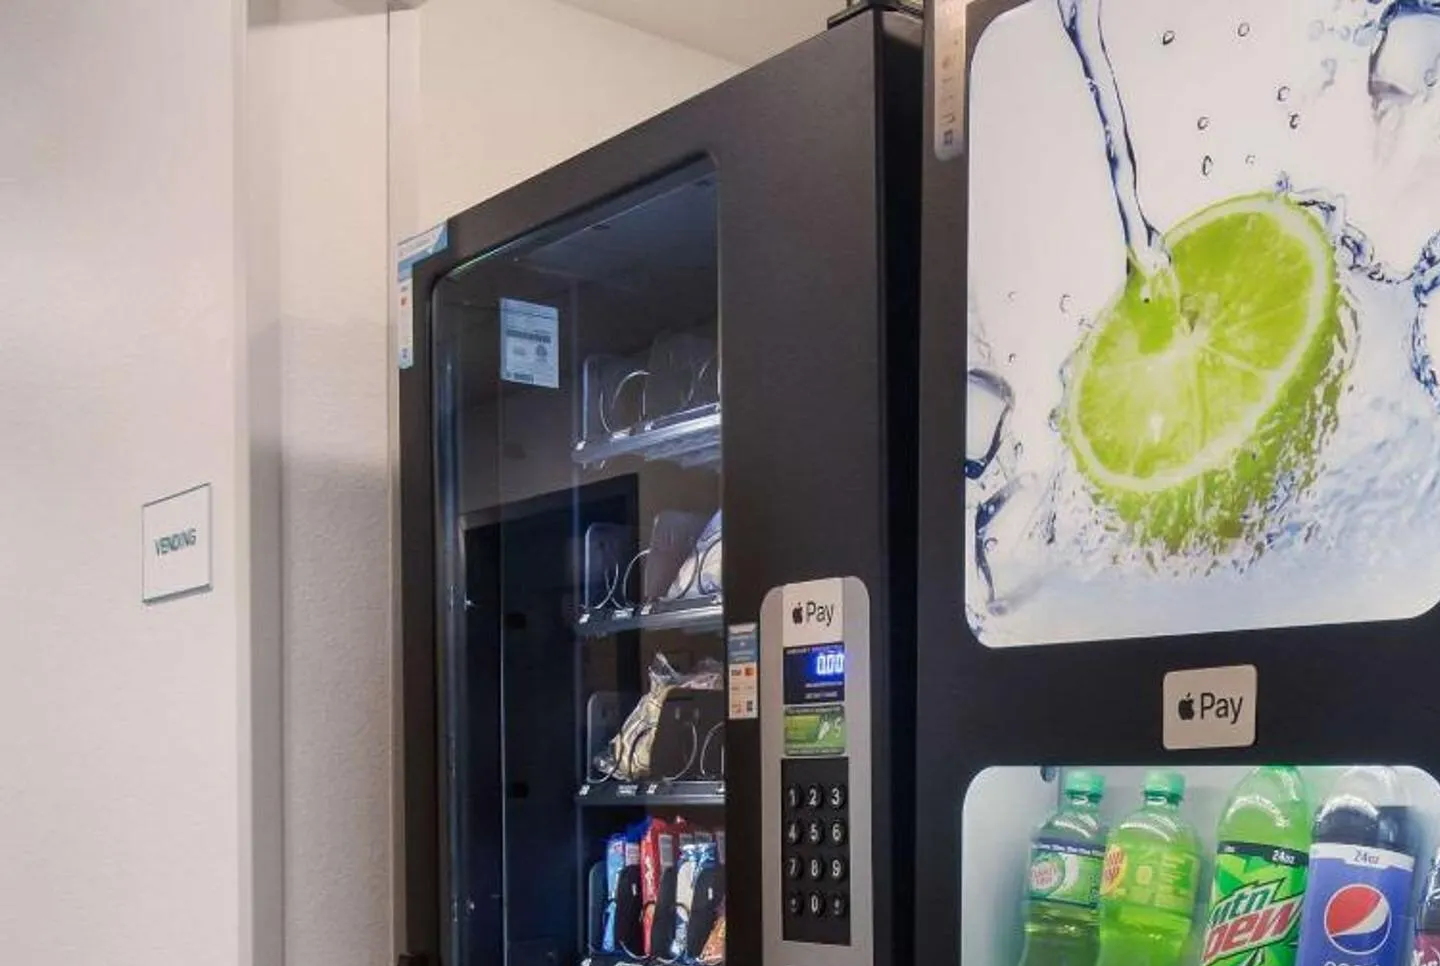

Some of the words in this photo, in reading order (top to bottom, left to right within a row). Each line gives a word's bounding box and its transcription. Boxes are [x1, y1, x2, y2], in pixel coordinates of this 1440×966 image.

[154, 528, 197, 556] VENDING
[805, 601, 834, 626] Pay
[1200, 692, 1243, 725] Pay
[789, 788, 796, 806] 1
[809, 788, 817, 806] 2
[831, 788, 840, 805] 3
[788, 823, 797, 842] 4
[810, 823, 818, 842] 5
[832, 823, 841, 841] 6
[1354, 850, 1380, 865] 24oz
[789, 858, 796, 876] 7
[811, 859, 819, 877] 8
[832, 859, 841, 877] 9
[811, 895, 818, 912] 0
